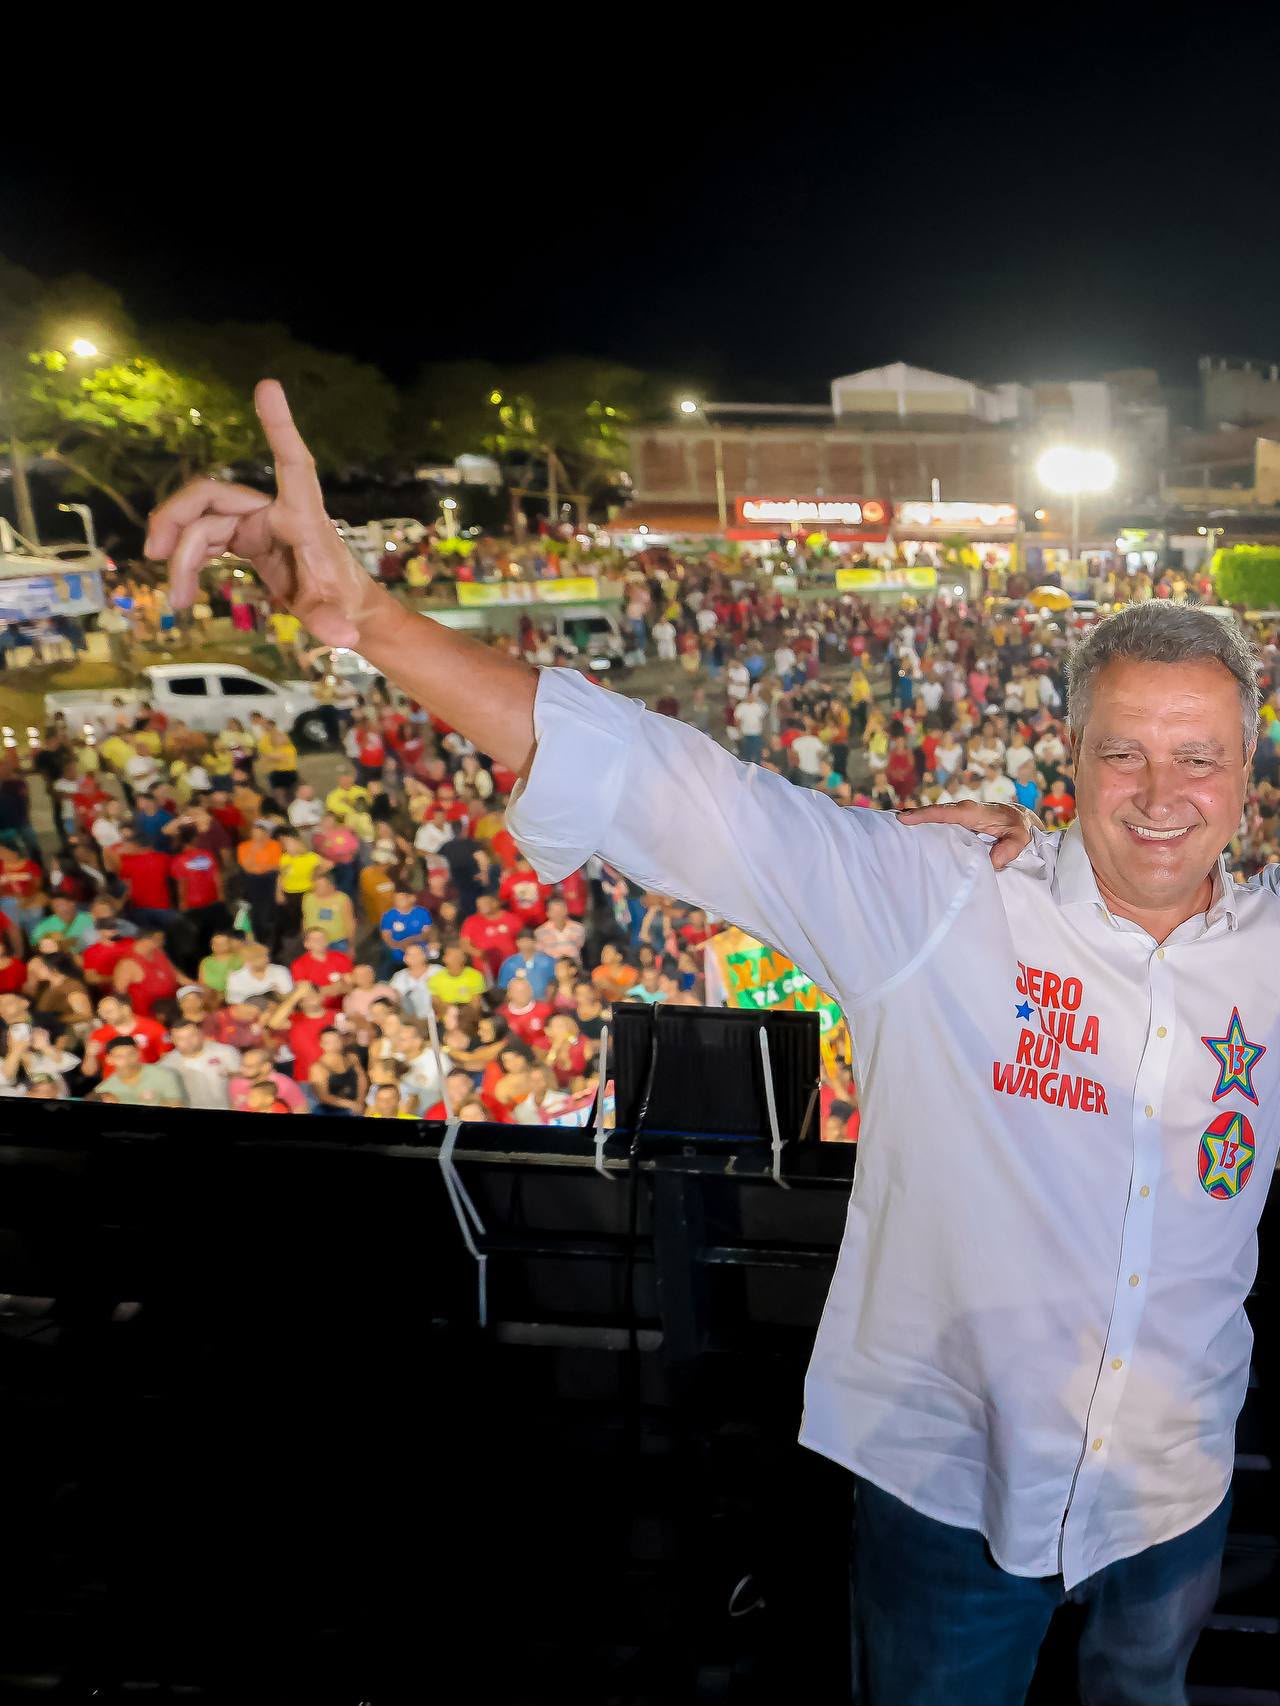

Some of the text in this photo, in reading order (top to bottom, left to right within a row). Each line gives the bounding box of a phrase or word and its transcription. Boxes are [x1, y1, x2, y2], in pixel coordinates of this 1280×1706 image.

[1015, 960, 1083, 1012] JERO
[1015, 1027, 1062, 1070] RUI
[1037, 1006, 1100, 1056] LULA
[1227, 1043, 1246, 1076] 13
[993, 1061, 1109, 1116] WAGNER
[1219, 1140, 1240, 1169] 13
